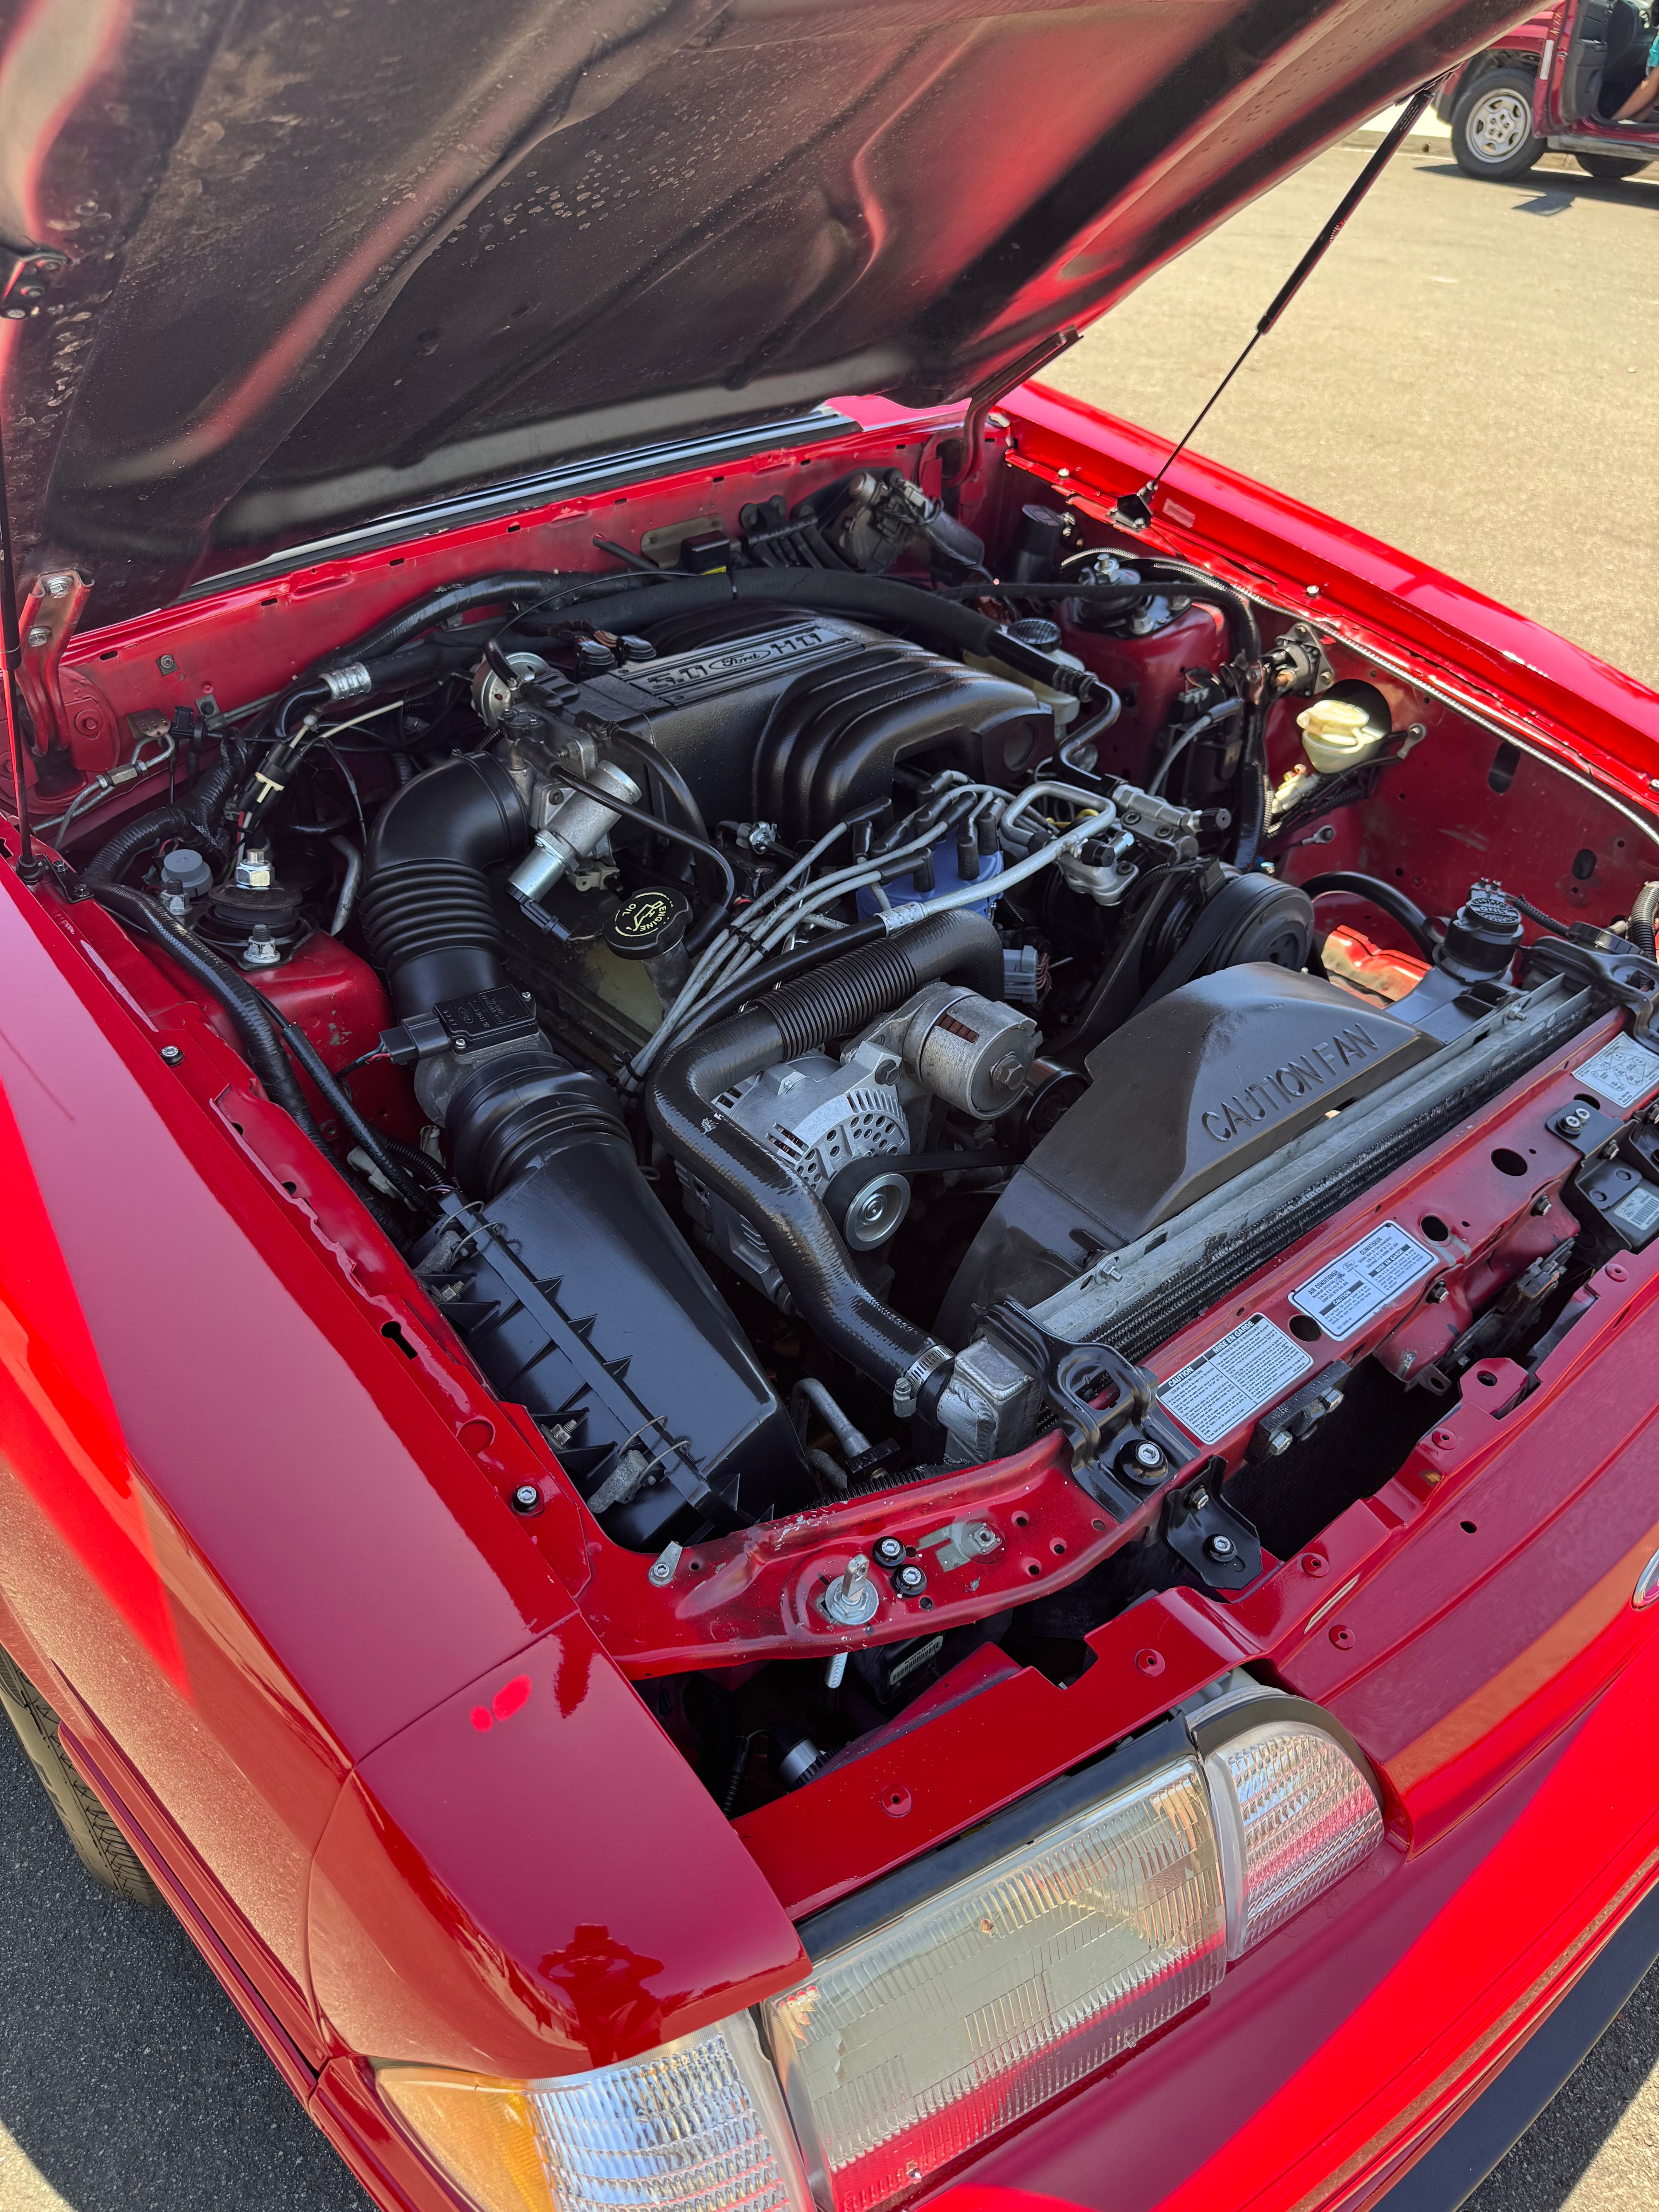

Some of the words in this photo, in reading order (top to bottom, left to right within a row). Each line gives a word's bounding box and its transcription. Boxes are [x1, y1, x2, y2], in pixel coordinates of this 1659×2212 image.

[647, 664, 708, 689] 5.0
[721, 653, 760, 666] Ford
[622, 903, 636, 916] OIL
[640, 905, 666, 931] ENGINE
[1201, 1055, 1325, 1142] CAUTION
[1312, 1023, 1379, 1075] FAN
[351, 1125, 371, 1148] CARB
[1359, 1237, 1382, 1255] CLIMATISEUR
[1374, 1263, 1386, 1273] MISE
[1389, 1249, 1404, 1261] GARDE
[1314, 1269, 1340, 1289] CONDITIONER
[1332, 1289, 1352, 1305] CAUTION
[1212, 1340, 1229, 1353] MISE
[1226, 1334, 1237, 1343] EN
[1234, 1321, 1254, 1338] GARDE
[1168, 1366, 1194, 1387] CAUTION
[1251, 1932, 1266, 1945] DOT
